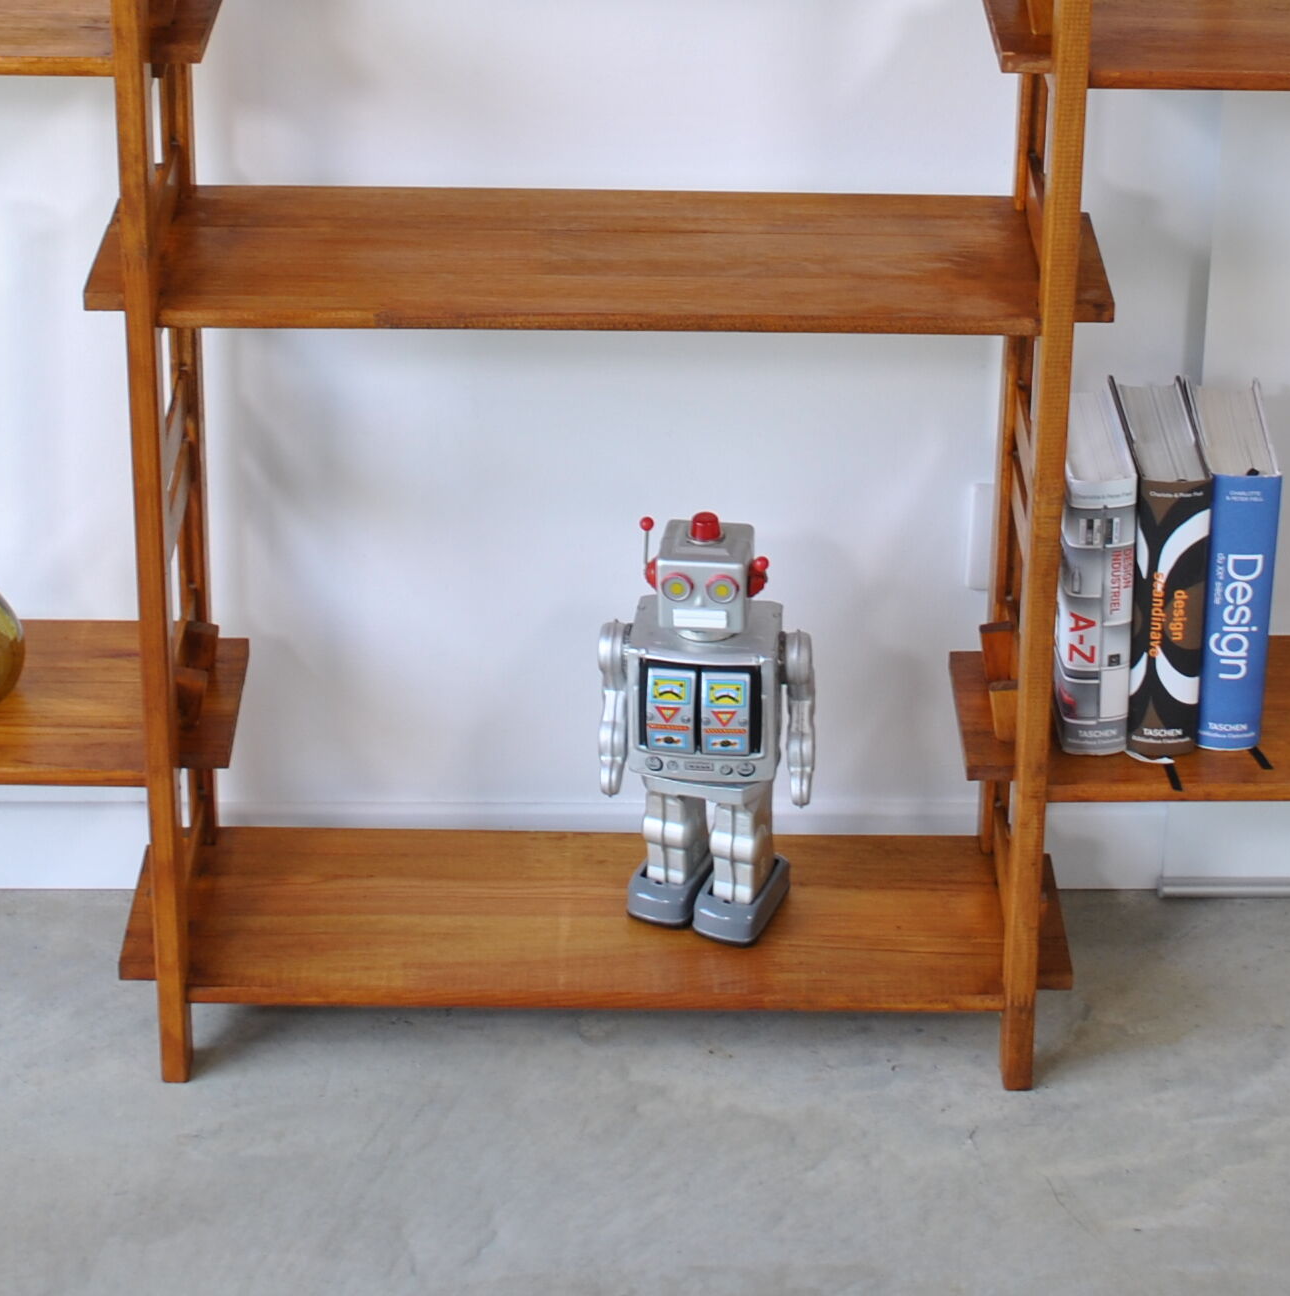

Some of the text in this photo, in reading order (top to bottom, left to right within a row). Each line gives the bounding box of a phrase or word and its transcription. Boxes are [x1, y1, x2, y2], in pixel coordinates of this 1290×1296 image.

[1110, 550, 1123, 615] INDUSTRIEL
[1123, 548, 1134, 590] DESIGN
[1069, 611, 1097, 665] A-Z
[1148, 572, 1166, 658] scandinave
[1168, 589, 1189, 641] design
[1209, 554, 1263, 680] Design
[1142, 727, 1184, 737] TASCHEN
[1207, 721, 1249, 732] TASCHEN
